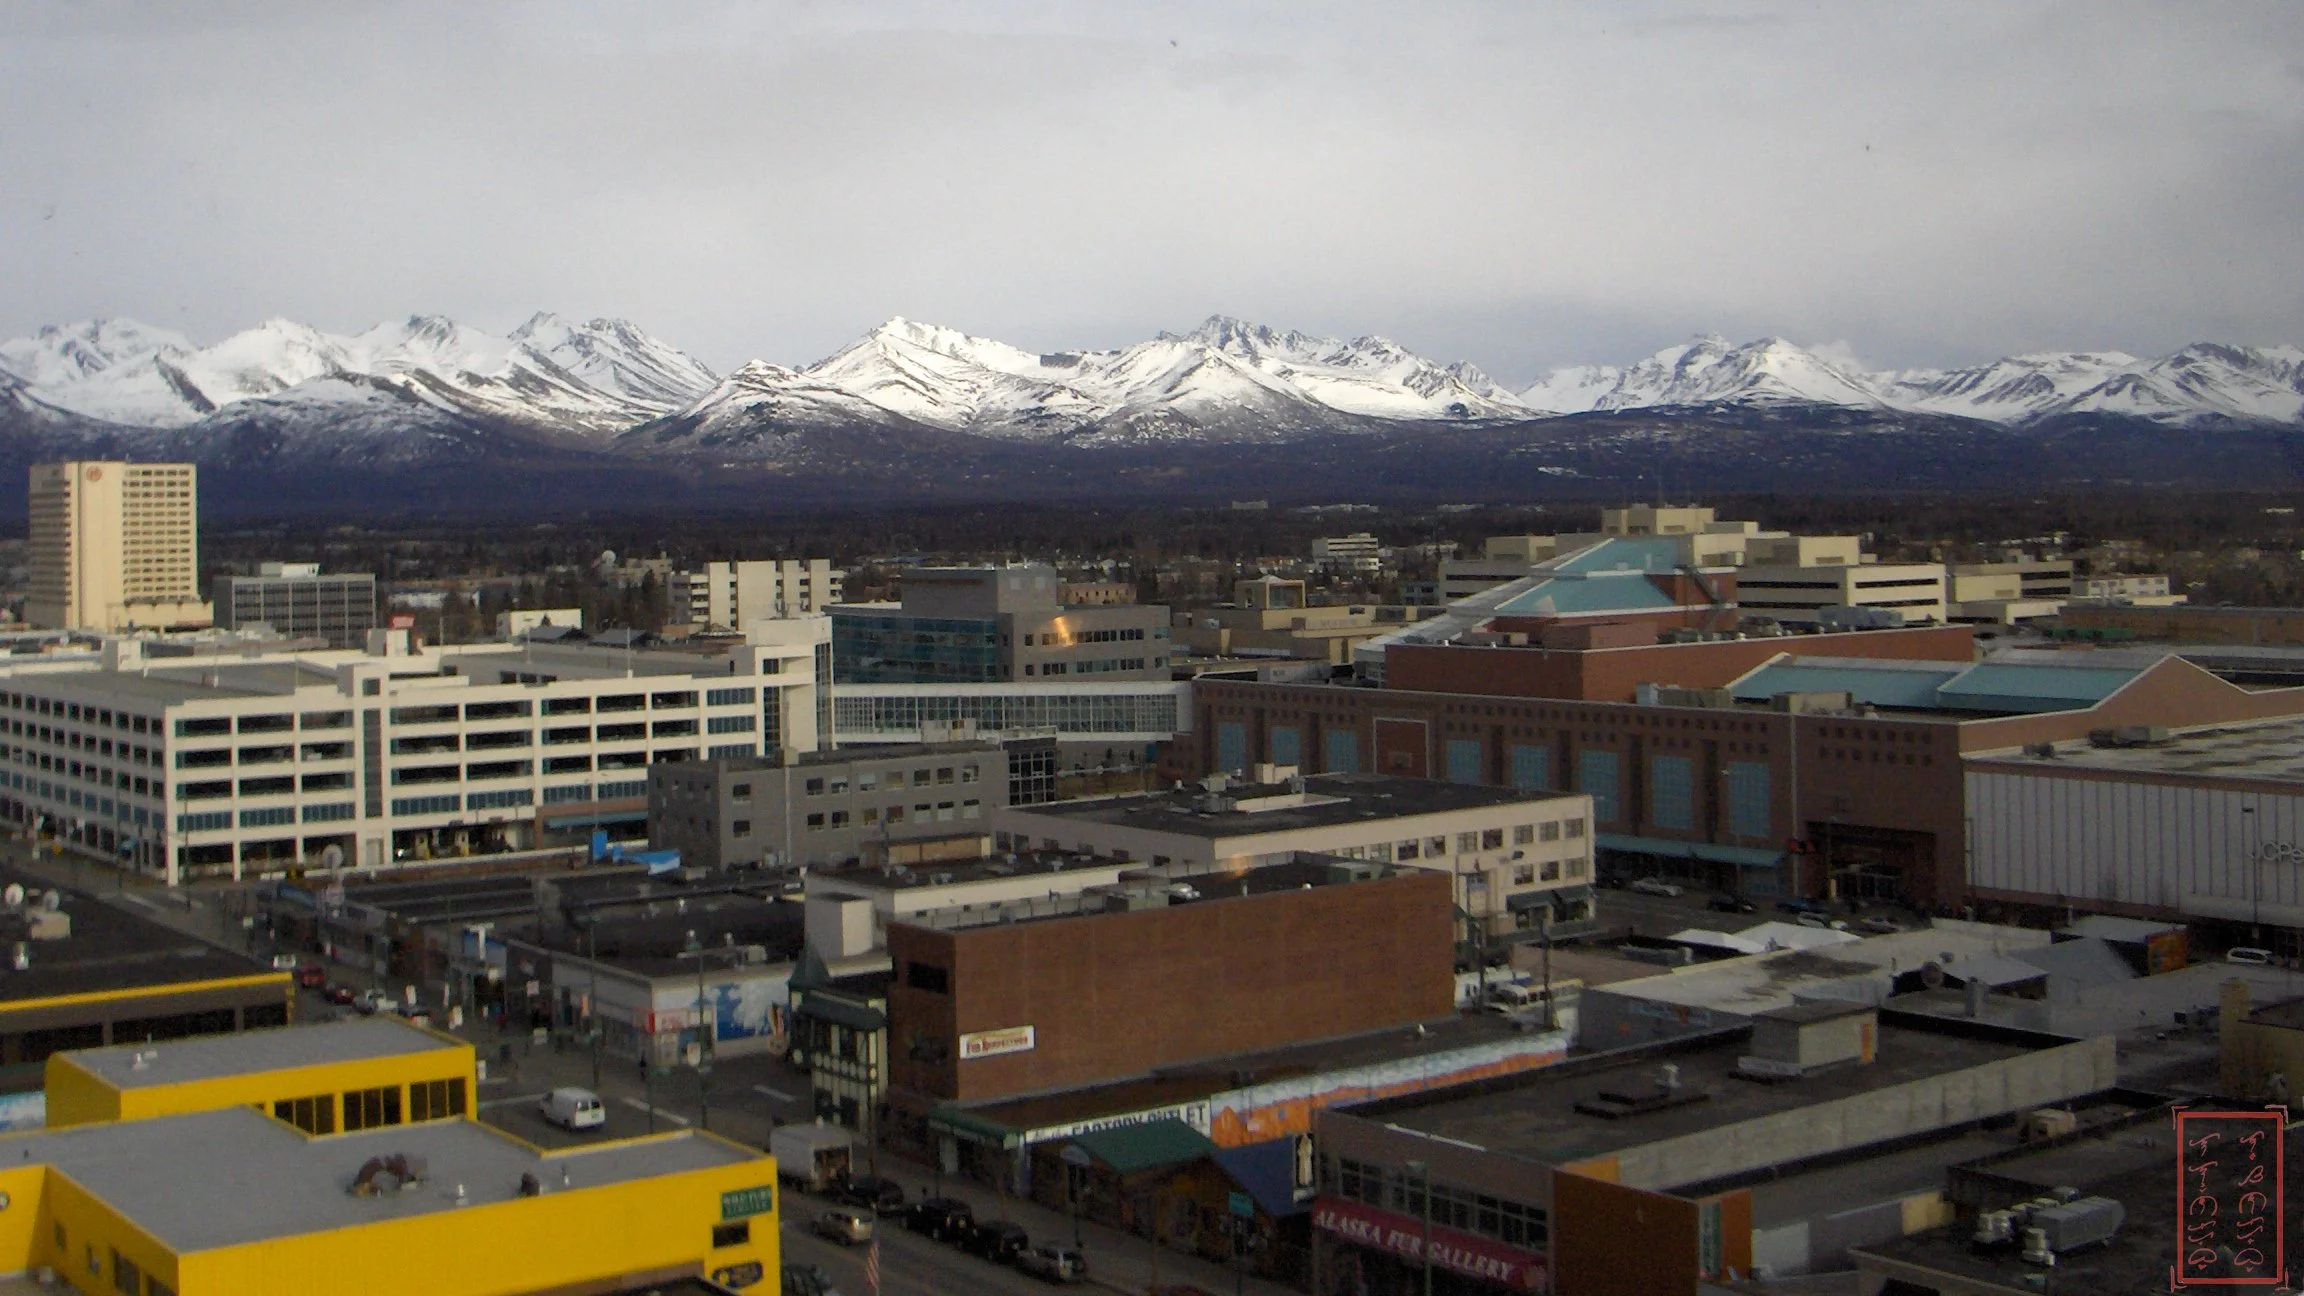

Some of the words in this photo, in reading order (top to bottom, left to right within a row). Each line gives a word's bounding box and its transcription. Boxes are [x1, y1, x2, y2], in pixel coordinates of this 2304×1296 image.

[1316, 1210, 1382, 1245] ALASKA
[1387, 1228, 1423, 1256] FUR
[1430, 1240, 1516, 1282] GALLERY
